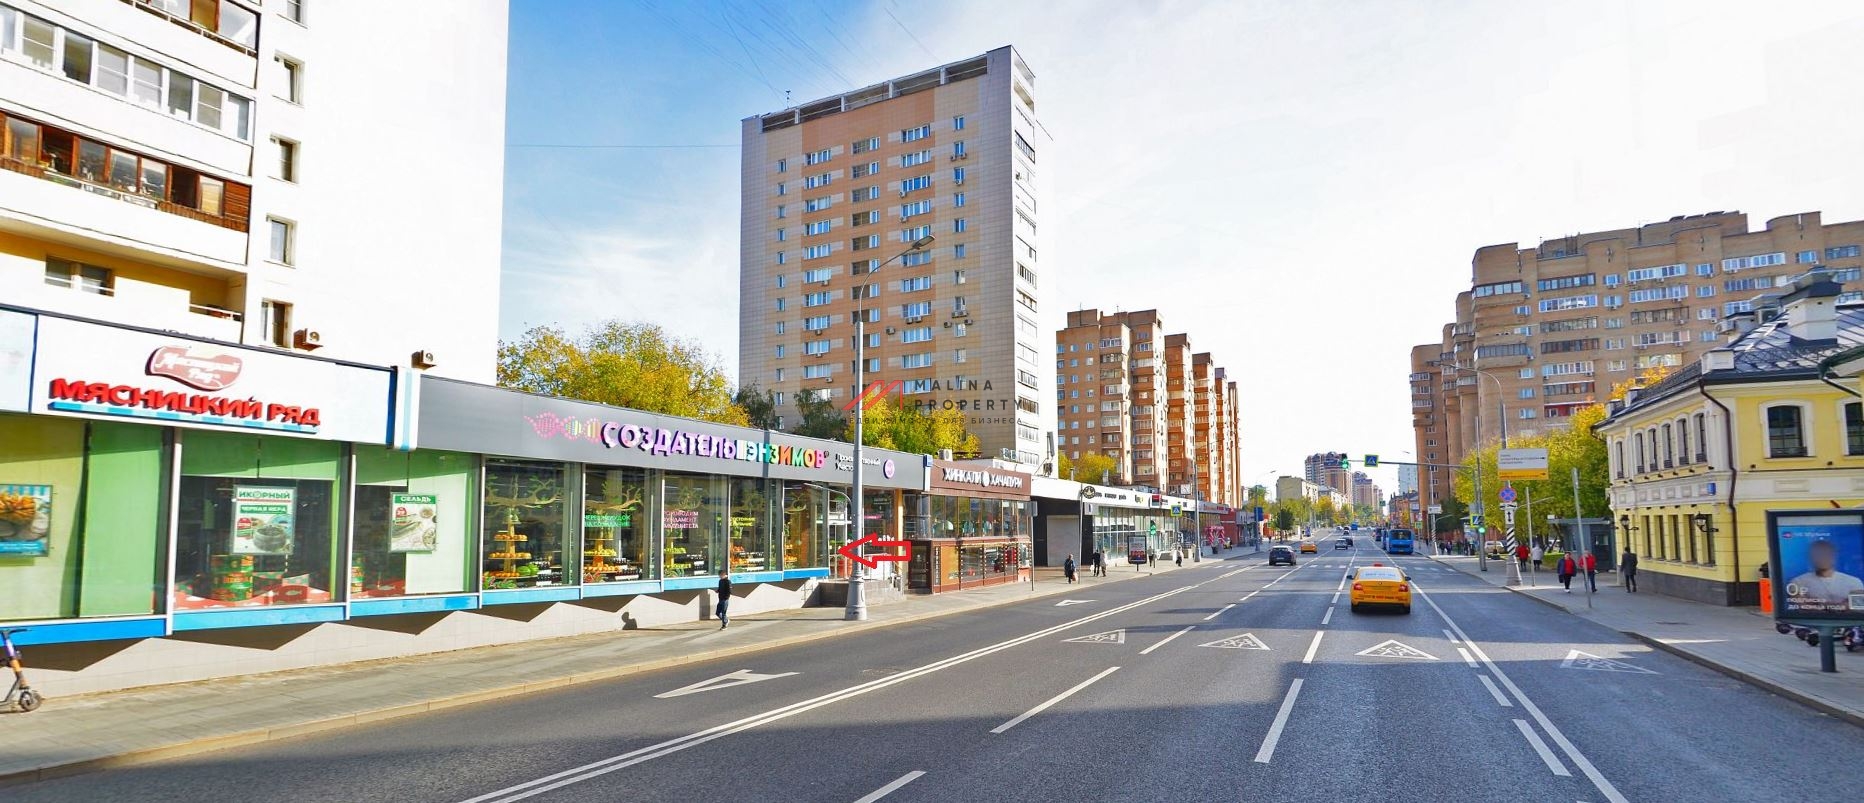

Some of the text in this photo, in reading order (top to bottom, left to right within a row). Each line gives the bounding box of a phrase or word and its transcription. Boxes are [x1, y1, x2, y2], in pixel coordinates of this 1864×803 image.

[49, 377, 321, 427] МЯСНИЦКИЙ РЯД
[601, 421, 736, 459] СОЗДАТЕЛЬ
[943, 467, 1023, 489] ХИНКАЛИ ХАЧАПУРИ
[239, 490, 290, 499] ИКОРНЫЙ
